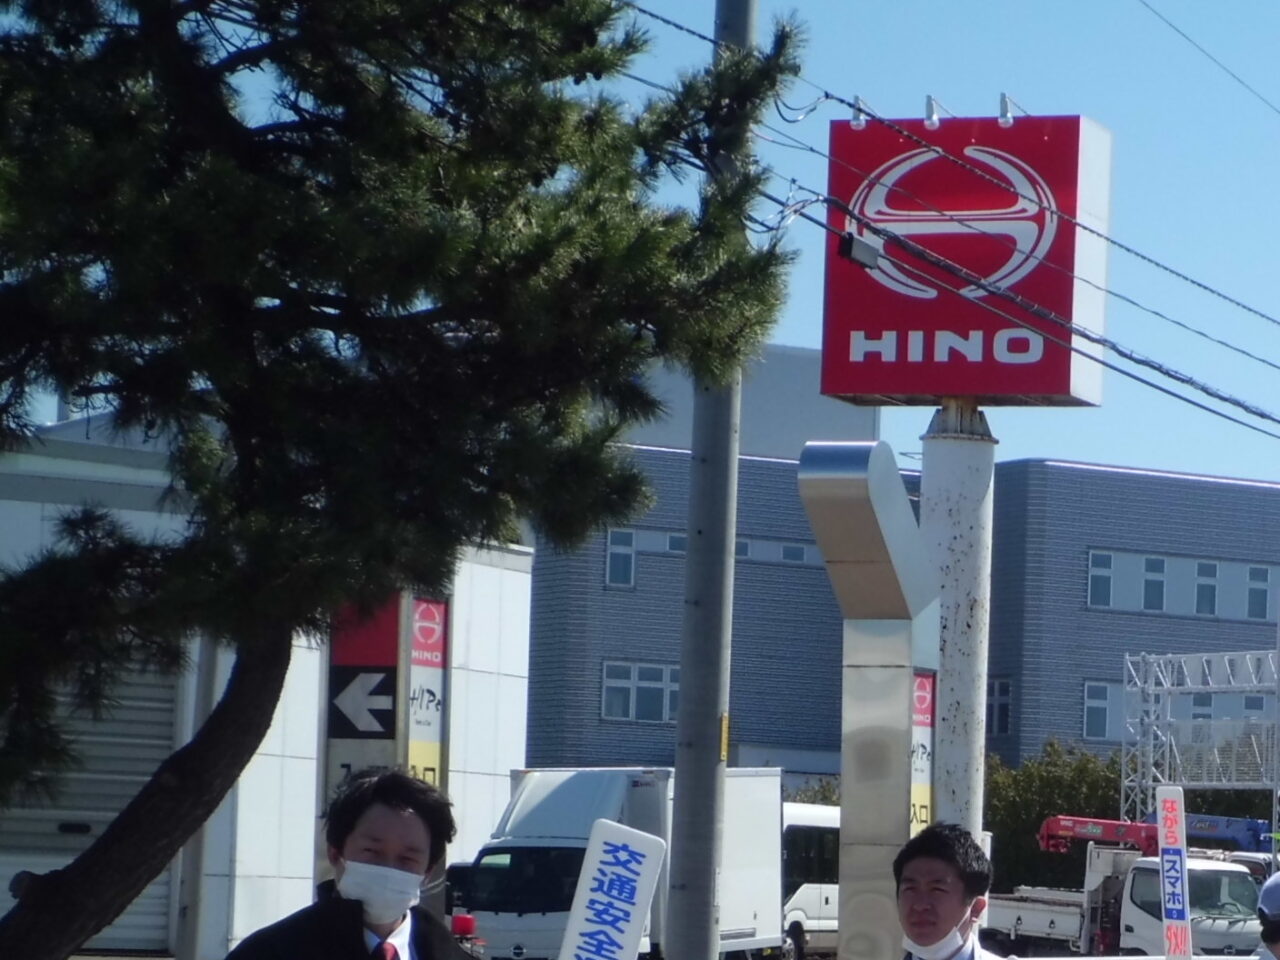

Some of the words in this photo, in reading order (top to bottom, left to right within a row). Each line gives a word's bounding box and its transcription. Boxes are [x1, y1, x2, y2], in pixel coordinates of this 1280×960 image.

[849, 328, 1044, 364] HINO
[411, 649, 441, 662] HINO
[910, 803, 929, 825] 入口
[1161, 799, 1179, 846] ながら
[1165, 859, 1182, 906] スマホ
